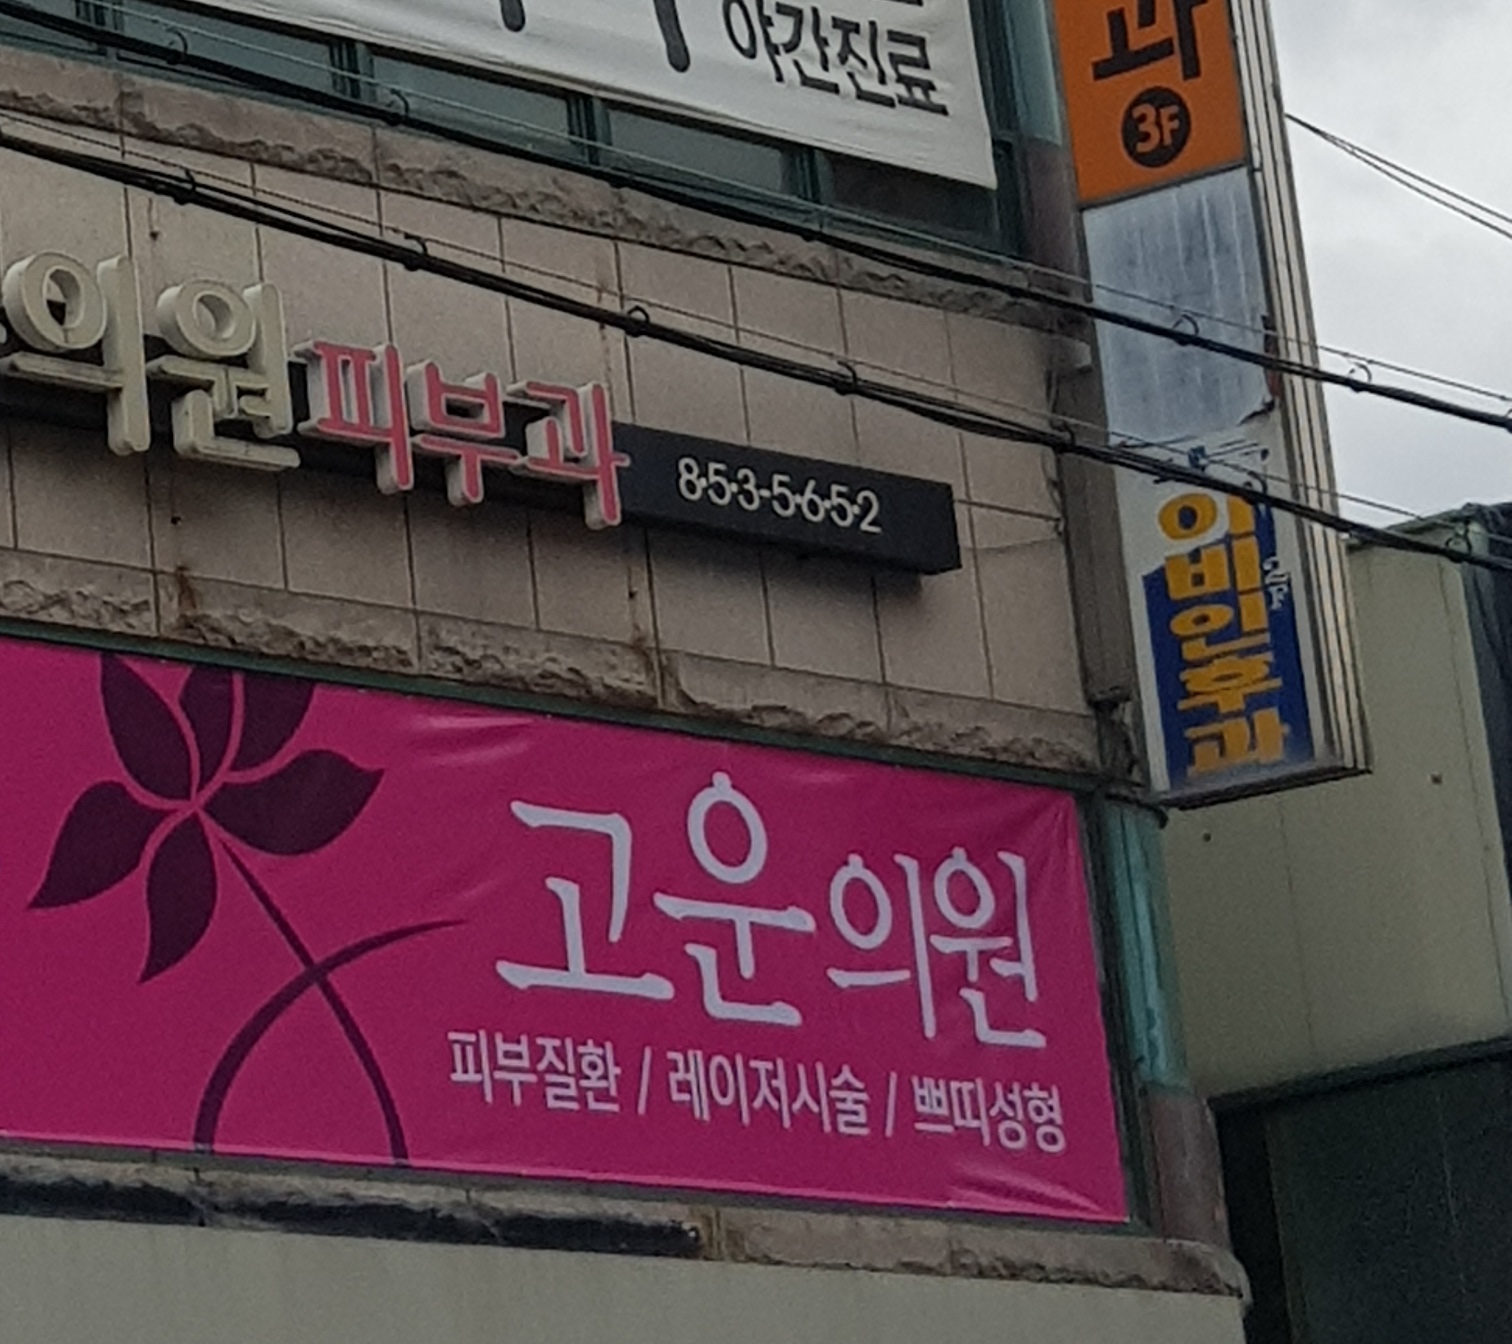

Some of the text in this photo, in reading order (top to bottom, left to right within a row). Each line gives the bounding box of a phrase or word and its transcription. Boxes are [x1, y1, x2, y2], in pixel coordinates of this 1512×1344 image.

[1132, 103, 1181, 156] 3F
[291, 339, 630, 529] 피부과
[494, 770, 1047, 1049] 고운의원
[446, 1028, 622, 1114] 피부질환
[666, 1049, 872, 1138] 레이저시술
[911, 1072, 1067, 1155] 쁘띠성형
